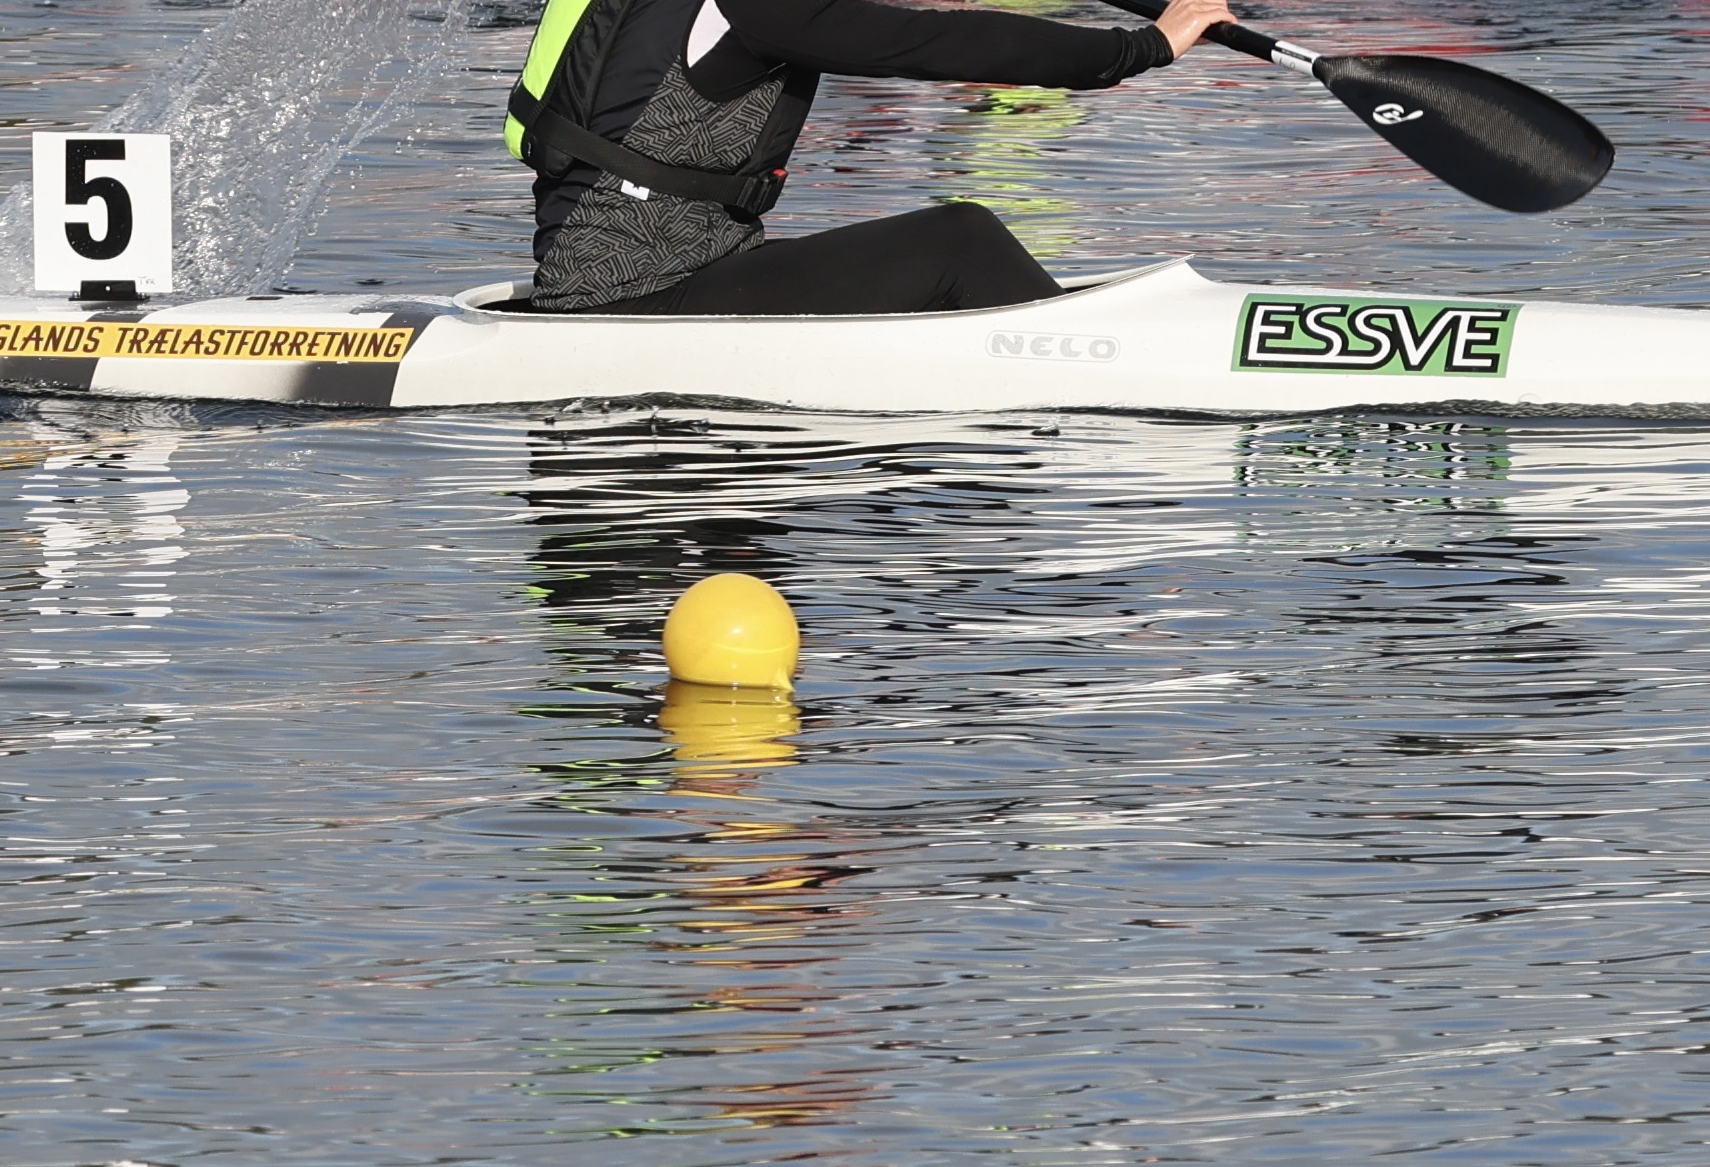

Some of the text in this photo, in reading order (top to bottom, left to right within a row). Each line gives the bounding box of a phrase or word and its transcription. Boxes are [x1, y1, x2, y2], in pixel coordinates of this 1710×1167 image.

[64, 139, 133, 261] 5
[114, 327, 406, 357] TRÆLASTFORRETNING
[991, 333, 1117, 360] NELO
[1239, 301, 1511, 373] ESSVE
